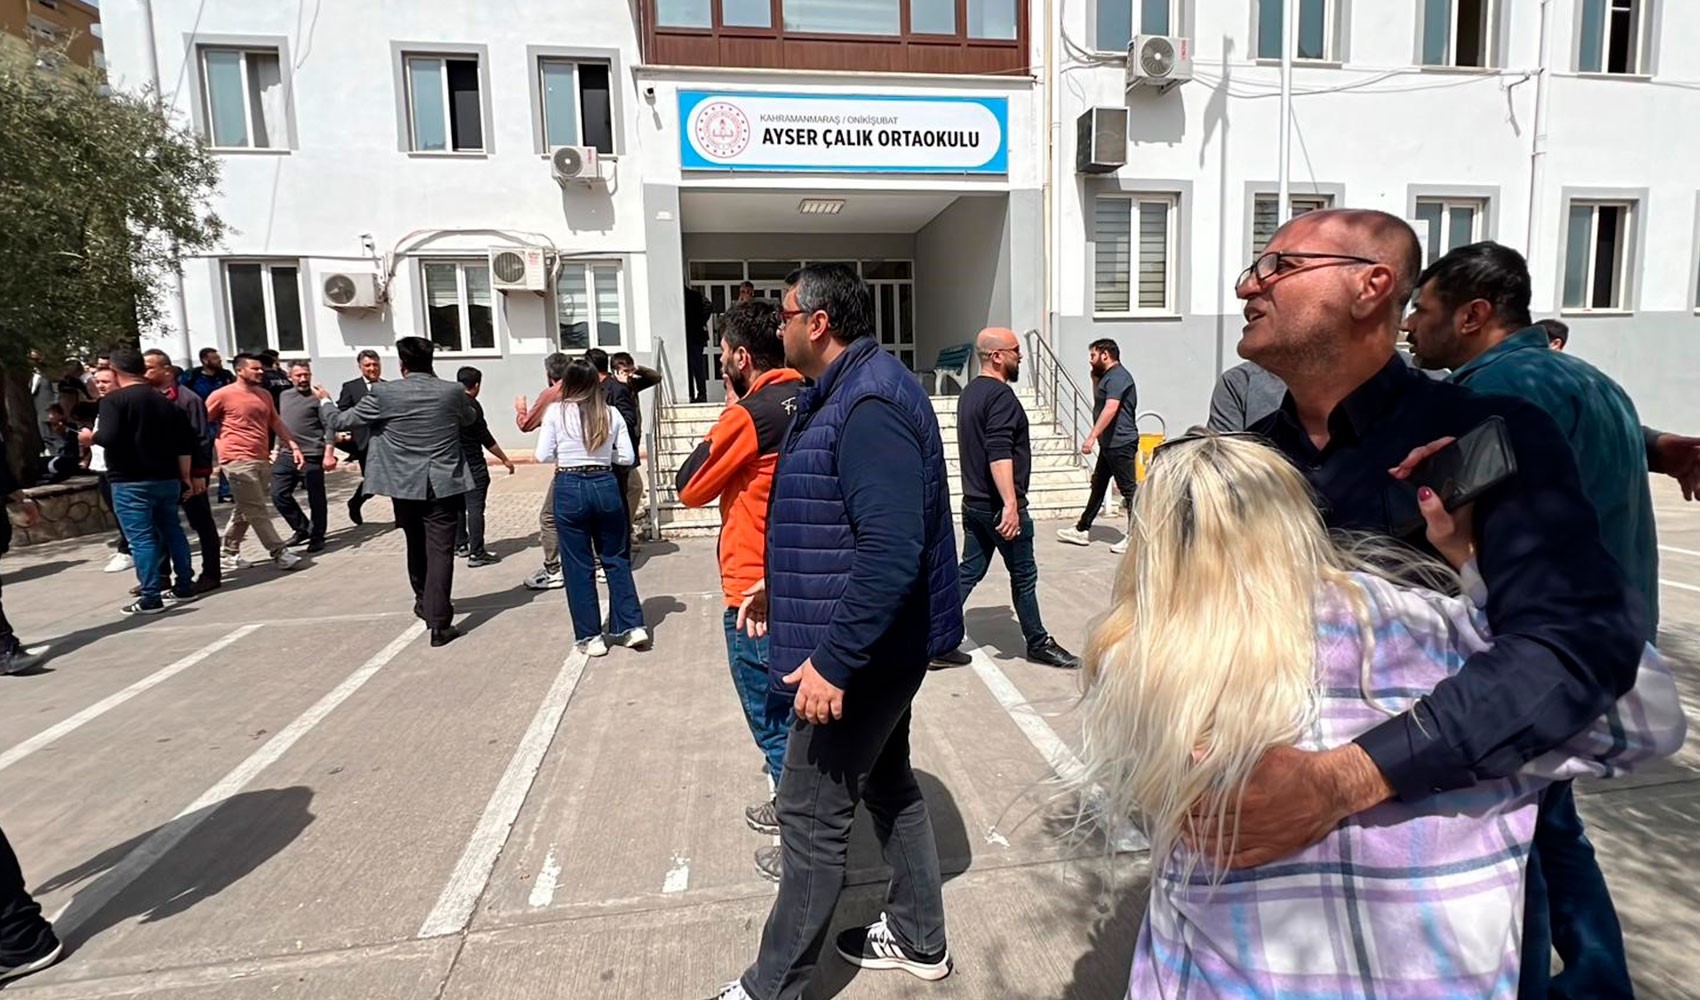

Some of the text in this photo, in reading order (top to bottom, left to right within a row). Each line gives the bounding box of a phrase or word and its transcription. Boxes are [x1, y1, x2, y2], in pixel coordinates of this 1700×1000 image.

[760, 114, 840, 125] KAHRAMANMARAŞ
[847, 115, 898, 126] ONİKİŞUBAT
[762, 128, 818, 145] AYSER
[822, 129, 873, 149] ÇALIK
[878, 130, 979, 147] ORTAOKULU
